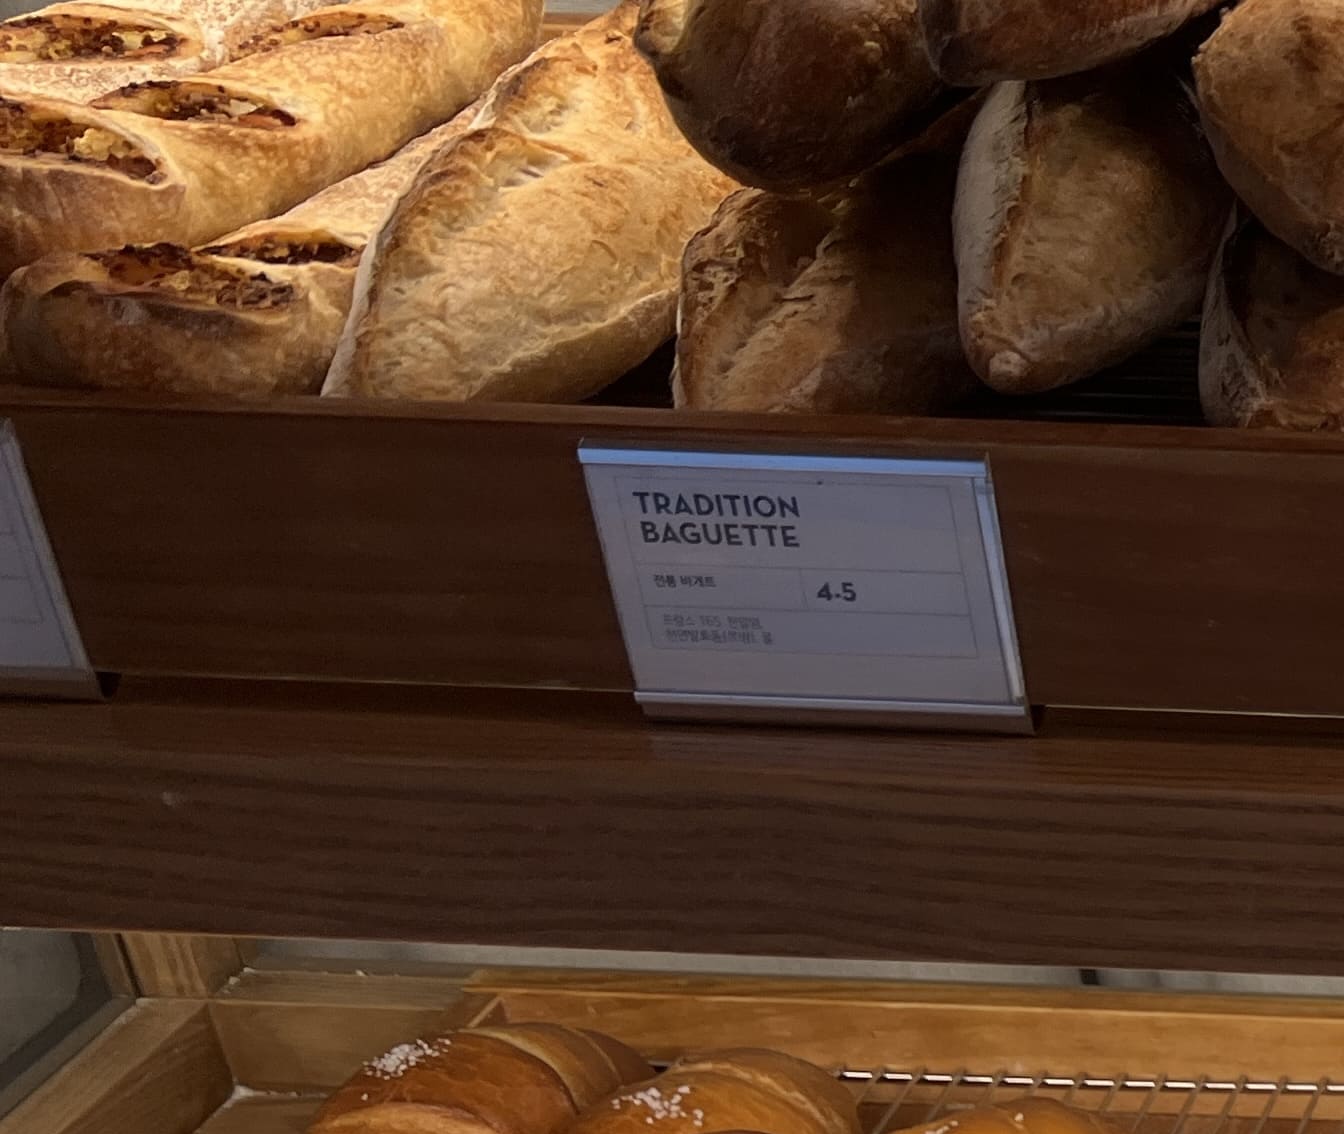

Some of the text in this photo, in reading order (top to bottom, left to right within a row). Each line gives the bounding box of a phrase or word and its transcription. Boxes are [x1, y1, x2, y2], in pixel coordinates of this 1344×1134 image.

[633, 491, 800, 518] TRADITION
[640, 520, 800, 547] BAGUETTE
[816, 582, 857, 602] 4.5
